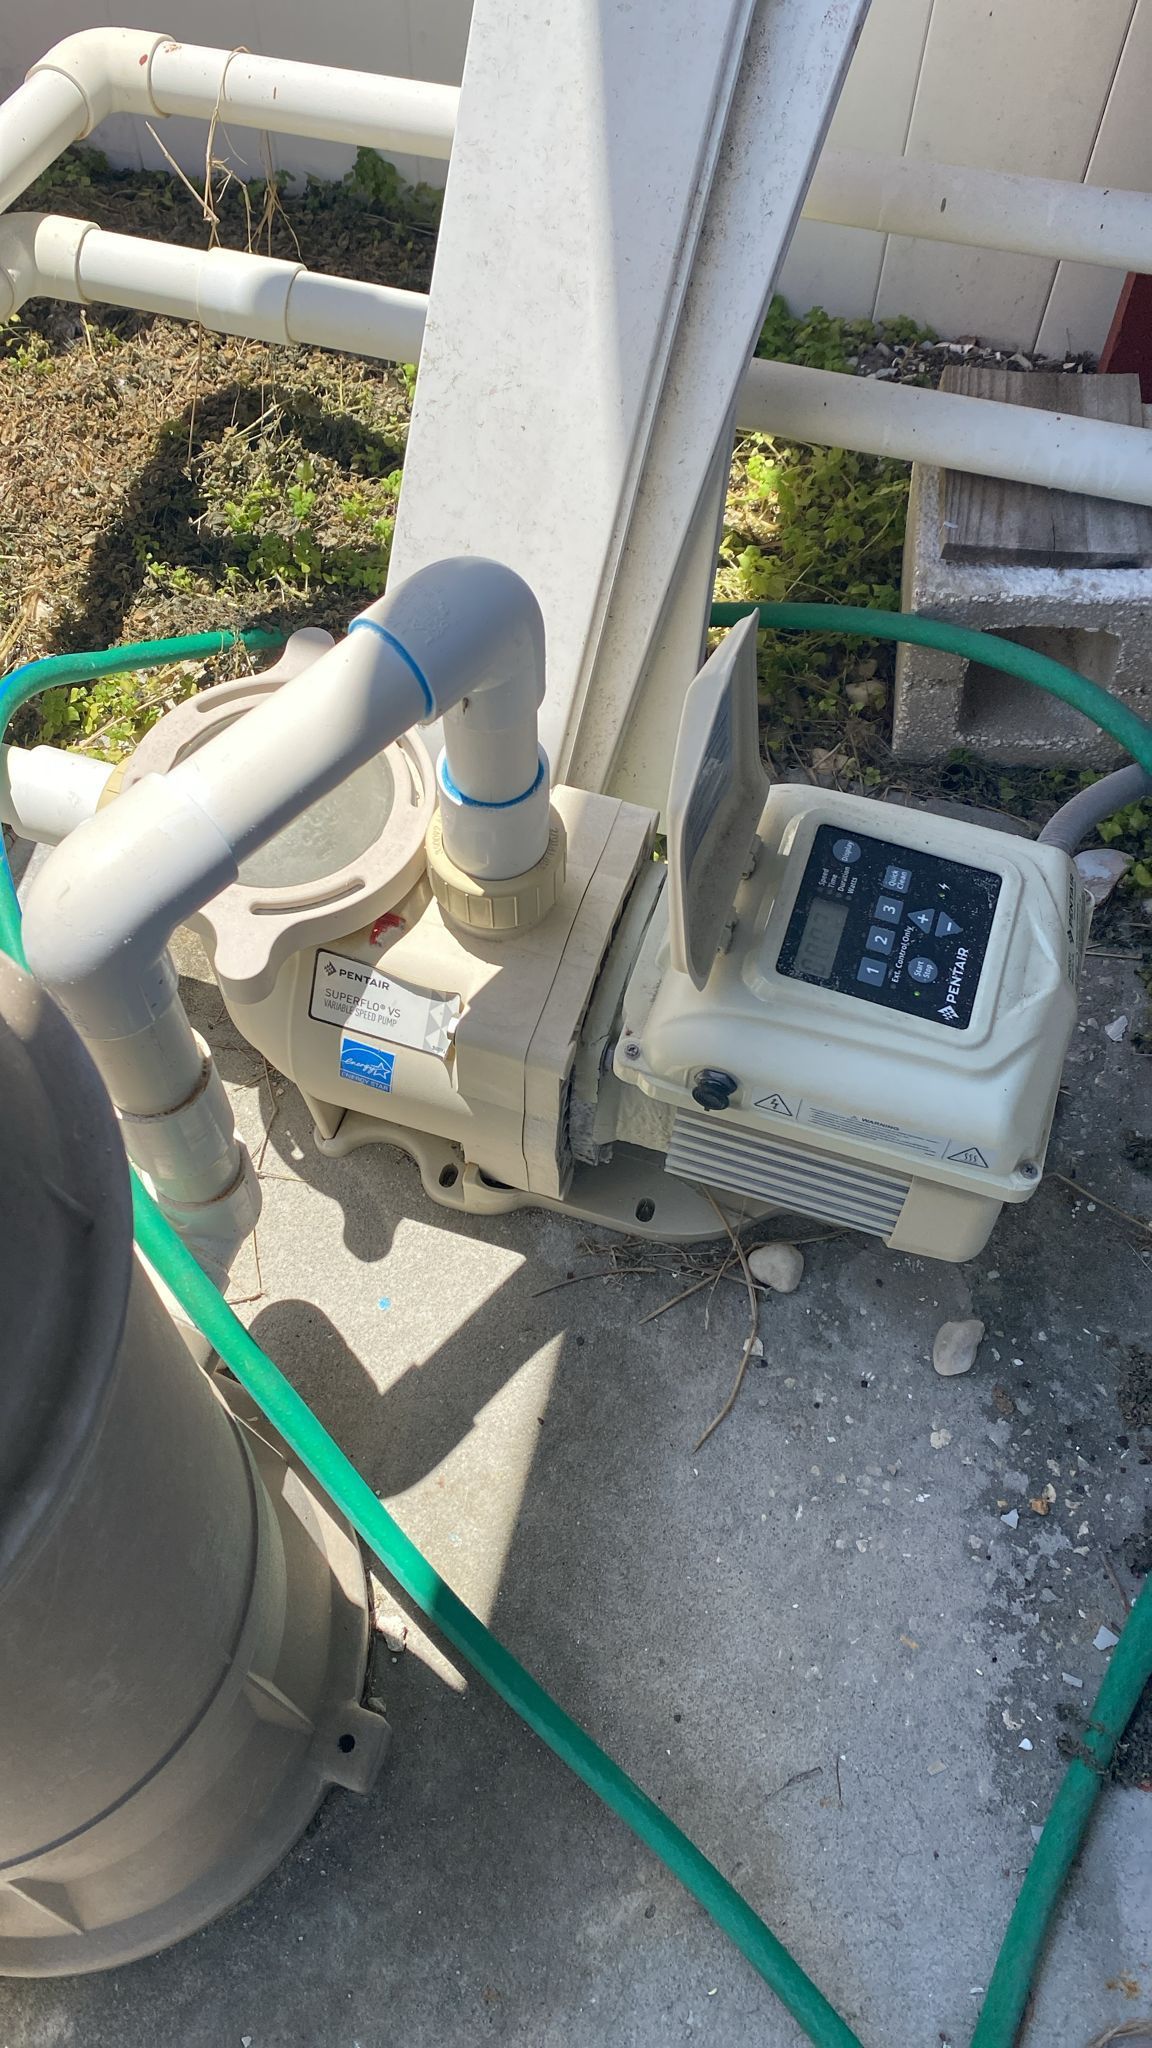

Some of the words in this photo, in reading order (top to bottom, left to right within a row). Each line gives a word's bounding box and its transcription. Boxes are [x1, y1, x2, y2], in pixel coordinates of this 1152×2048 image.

[841, 841, 855, 862] Display
[818, 868, 830, 887] Speed
[828, 874, 838, 888] Time
[837, 866, 851, 892] Duration
[847, 877, 858, 894] Watts
[888, 870, 899, 887] Quick
[897, 871, 908, 890] Clean
[882, 905, 896, 915] 3
[874, 935, 888, 946] 2
[895, 942, 907, 969] Control
[902, 925, 914, 945] Only
[914, 961, 925, 977] Start
[923, 964, 934, 979] Stop
[946, 947, 969, 1004] PENTAIR
[338, 968, 390, 991] PENTAIR
[324, 999, 354, 1015] VARIABLE
[354, 1007, 377, 1022] SPEED
[377, 1014, 398, 1027] PUMP
[388, 1006, 401, 1019] VS
[341, 1071, 369, 1086] ENERGY
[371, 1080, 389, 1091] STAR
[861, 1117, 900, 1131] WARNING
